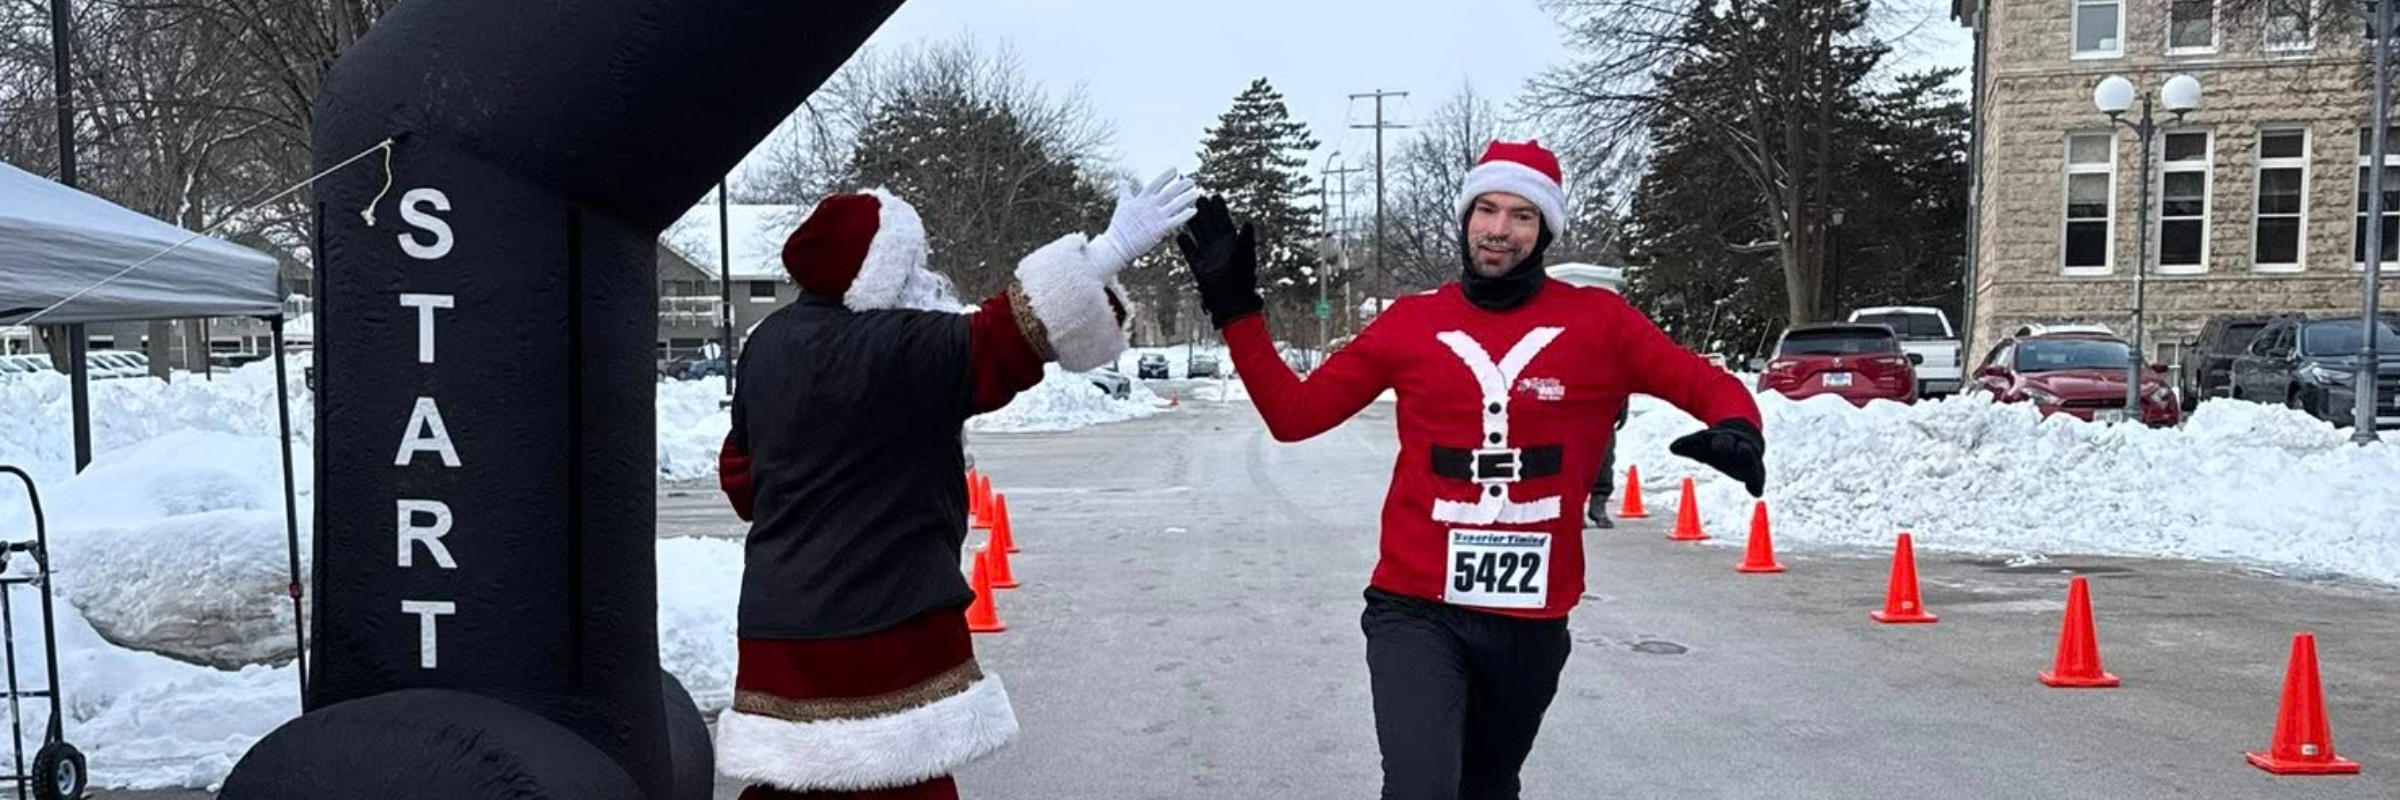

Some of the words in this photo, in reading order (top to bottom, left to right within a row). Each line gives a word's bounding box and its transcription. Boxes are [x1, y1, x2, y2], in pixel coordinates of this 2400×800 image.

[394, 187, 462, 670] START
[1507, 534, 1547, 545] Timing
[1454, 551, 1541, 593] 5422
